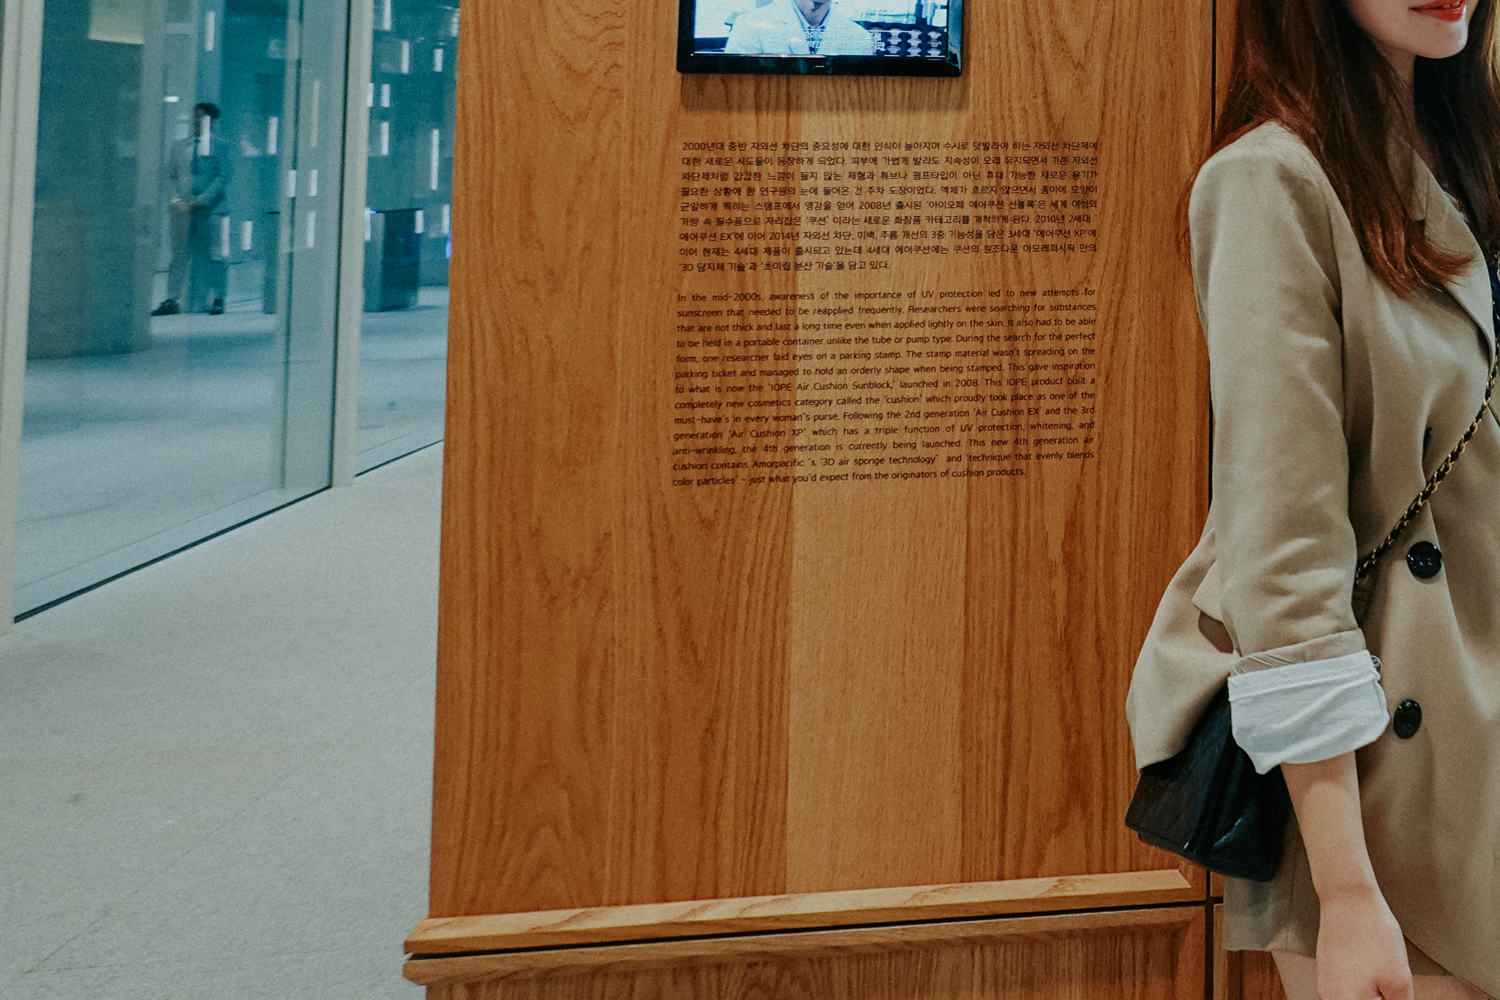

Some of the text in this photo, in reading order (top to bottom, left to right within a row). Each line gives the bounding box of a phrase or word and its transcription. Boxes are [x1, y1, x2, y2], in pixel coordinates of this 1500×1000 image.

[677, 292, 686, 301] In
[691, 292, 707, 301] the
[819, 290, 829, 299] of
[834, 290, 849, 299] the
[854, 289, 902, 299] importance
[906, 289, 916, 298] of
[920, 288, 934, 297] UV
[939, 288, 982, 298] protection
[988, 288, 1000, 296] led
[1005, 287, 1015, 296] to
[1042, 287, 1079, 297] attempts
[1082, 286, 1095, 295] for
[726, 306, 744, 316] that
[748, 306, 781, 315] needed
[785, 306, 796, 315] to
[798, 305, 810, 314] be
[812, 305, 854, 315] reapplied
[907, 303, 962, 313] Researchers
[989, 302, 1030, 312] searching
[1032, 302, 1045, 311] for
[1049, 301, 1097, 310] substances
[673, 429, 723, 440] generation
[749, 427, 786, 437] Cushion
[811, 426, 837, 435] which
[842, 425, 859, 434] has
[874, 424, 901, 435] triple
[903, 423, 940, 433] function
[945, 423, 955, 432] of
[959, 422, 973, 431] UV
[1078, 419, 1094, 428] and
